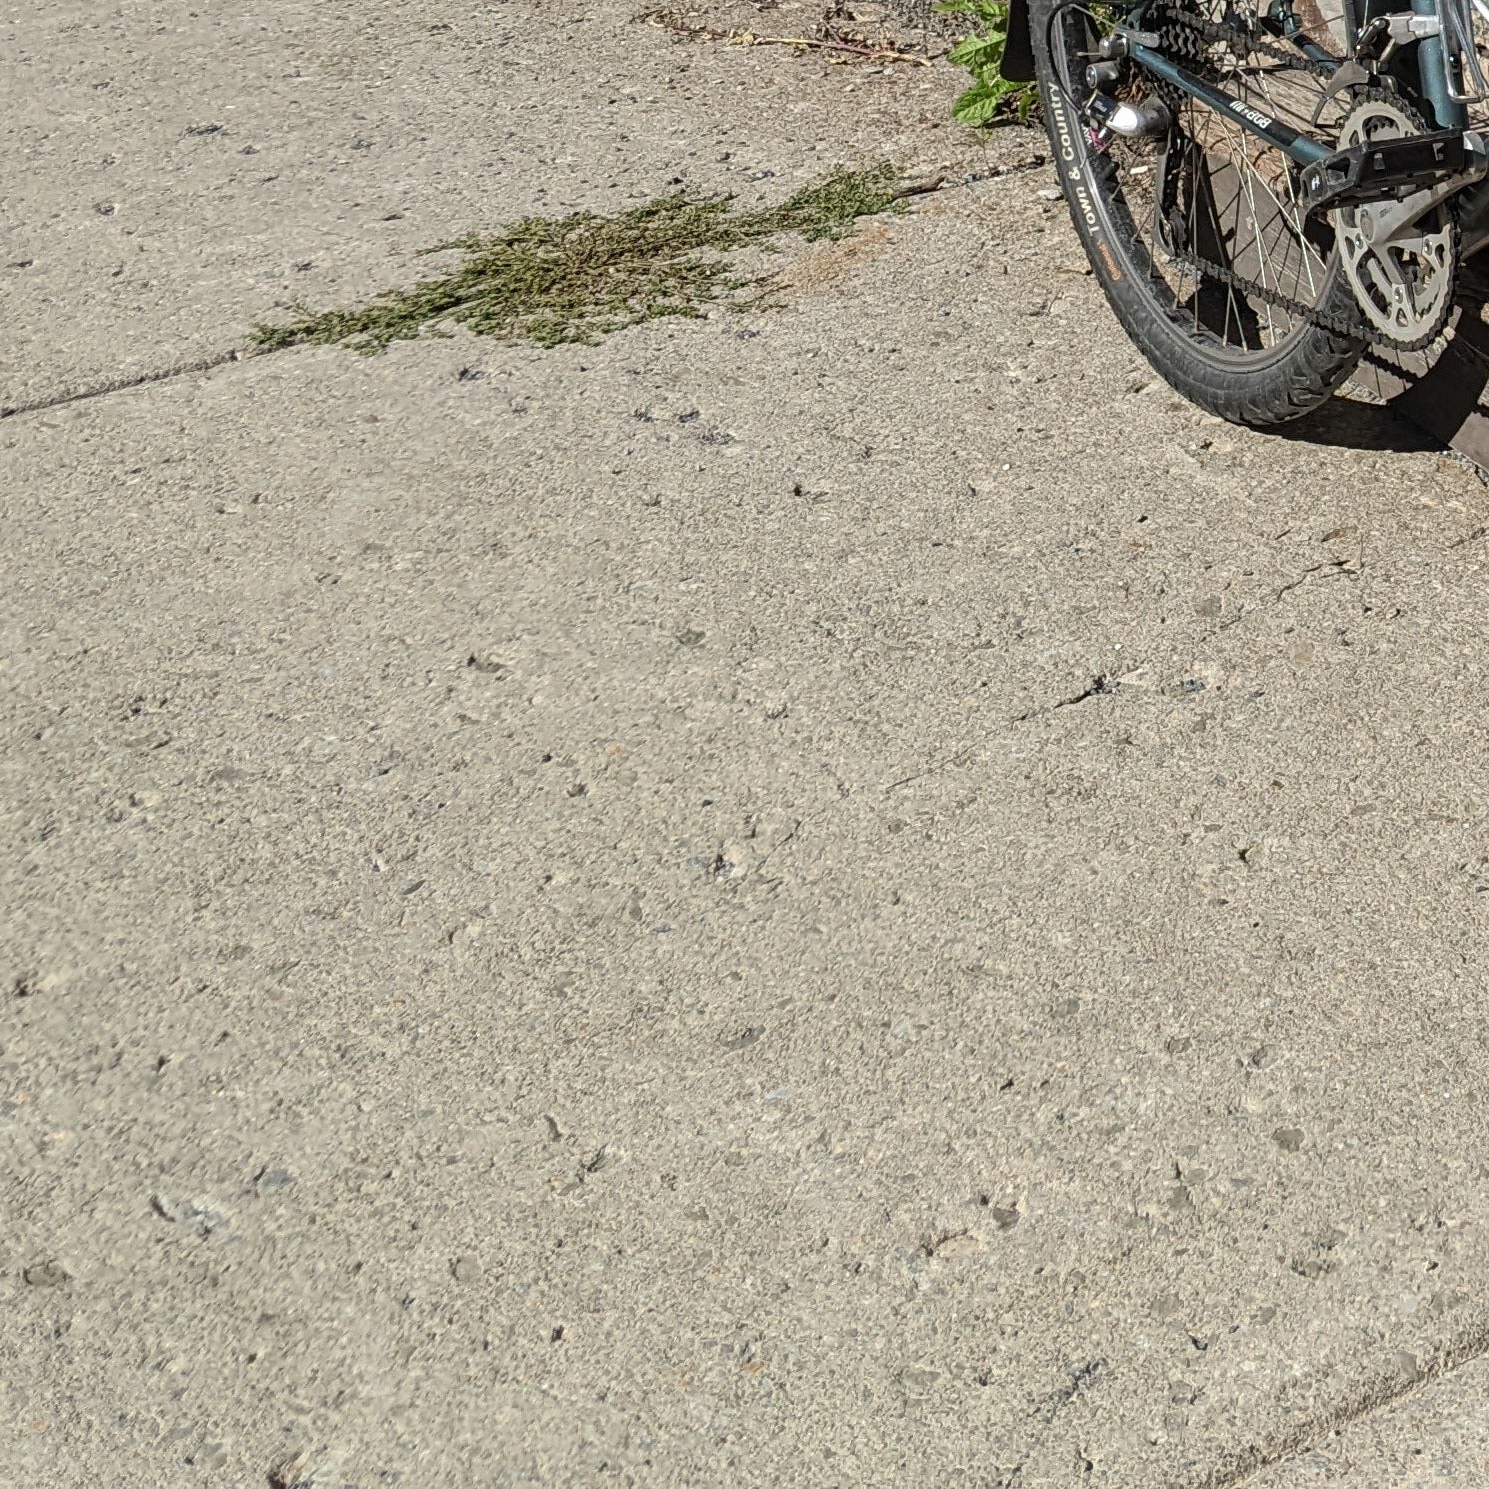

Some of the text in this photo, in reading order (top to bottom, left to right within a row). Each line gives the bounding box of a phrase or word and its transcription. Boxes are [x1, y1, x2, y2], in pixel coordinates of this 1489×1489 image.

[1047, 81, 1100, 237] Town & Country
